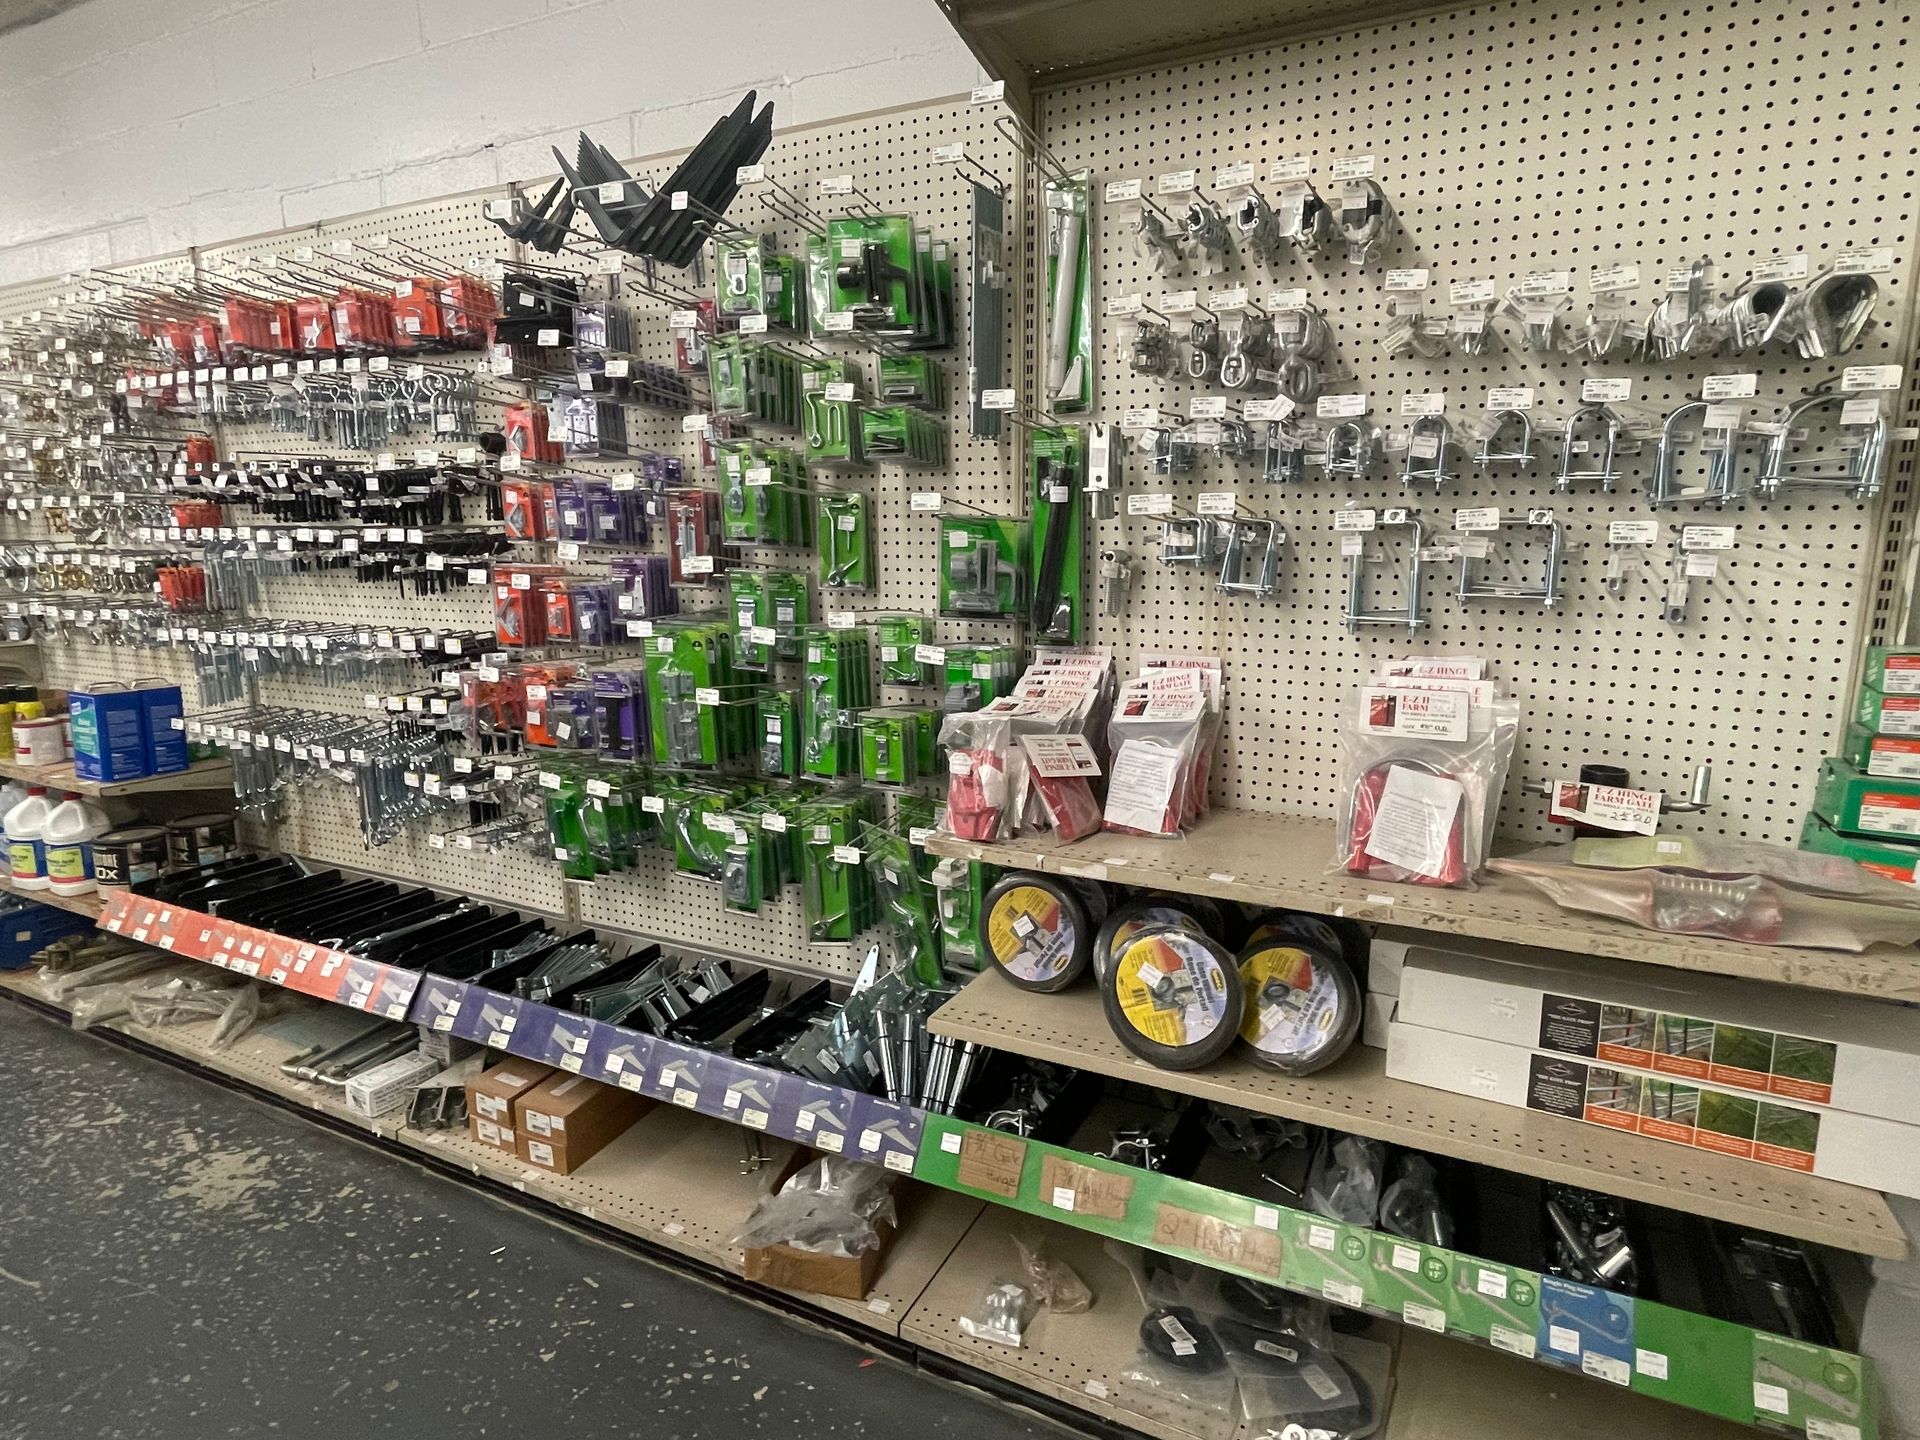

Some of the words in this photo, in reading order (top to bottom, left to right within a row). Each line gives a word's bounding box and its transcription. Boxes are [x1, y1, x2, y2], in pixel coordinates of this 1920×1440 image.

[1402, 702, 1430, 712] FARM
[1595, 794, 1626, 805] FARM
[1627, 799, 1655, 809] GATE
[1616, 790, 1655, 802] HINGE
